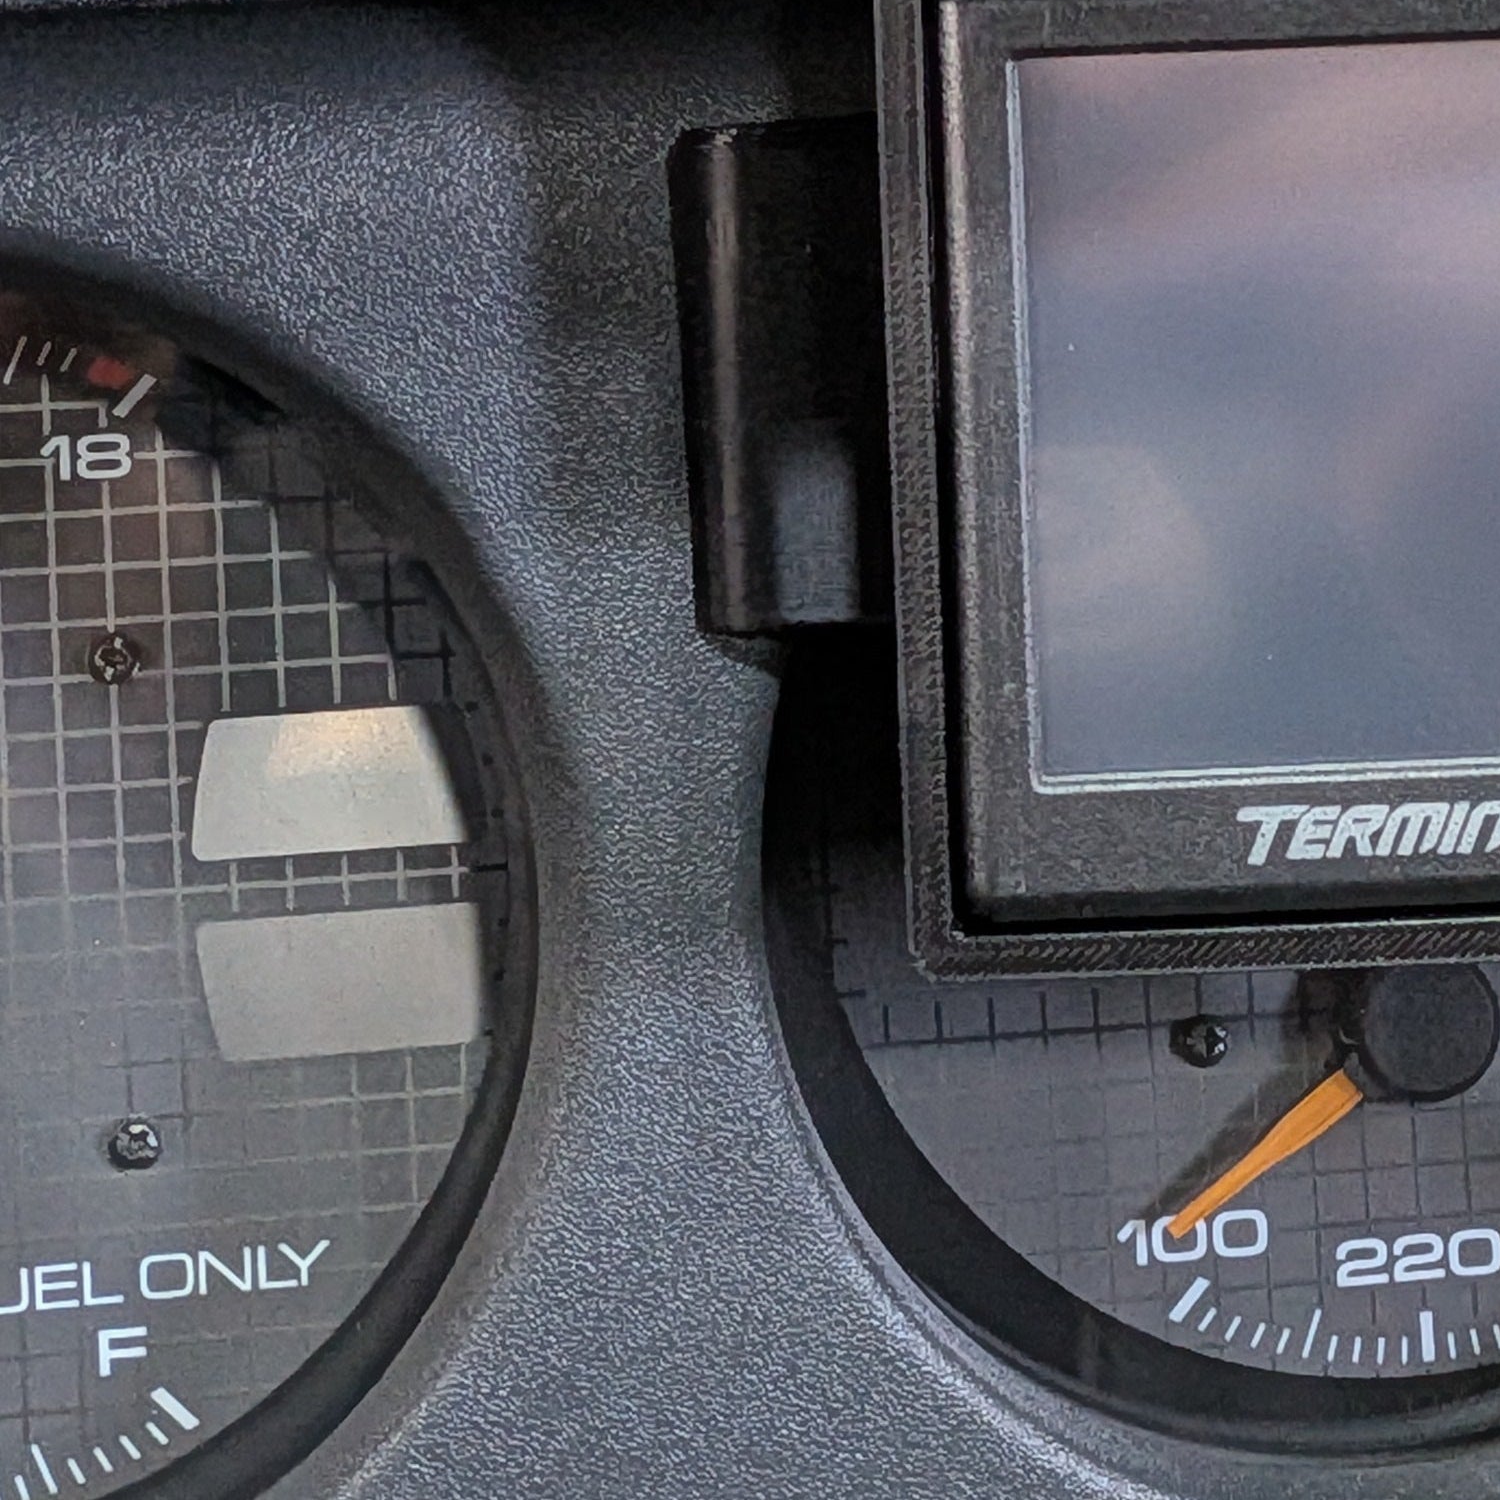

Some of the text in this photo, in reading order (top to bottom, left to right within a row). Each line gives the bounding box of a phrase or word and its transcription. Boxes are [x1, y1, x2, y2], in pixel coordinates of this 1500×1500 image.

[39, 432, 133, 482] 18
[1116, 1208, 1269, 1266] 100
[138, 1239, 331, 1300] ONLY
[98, 1326, 148, 1377] F
